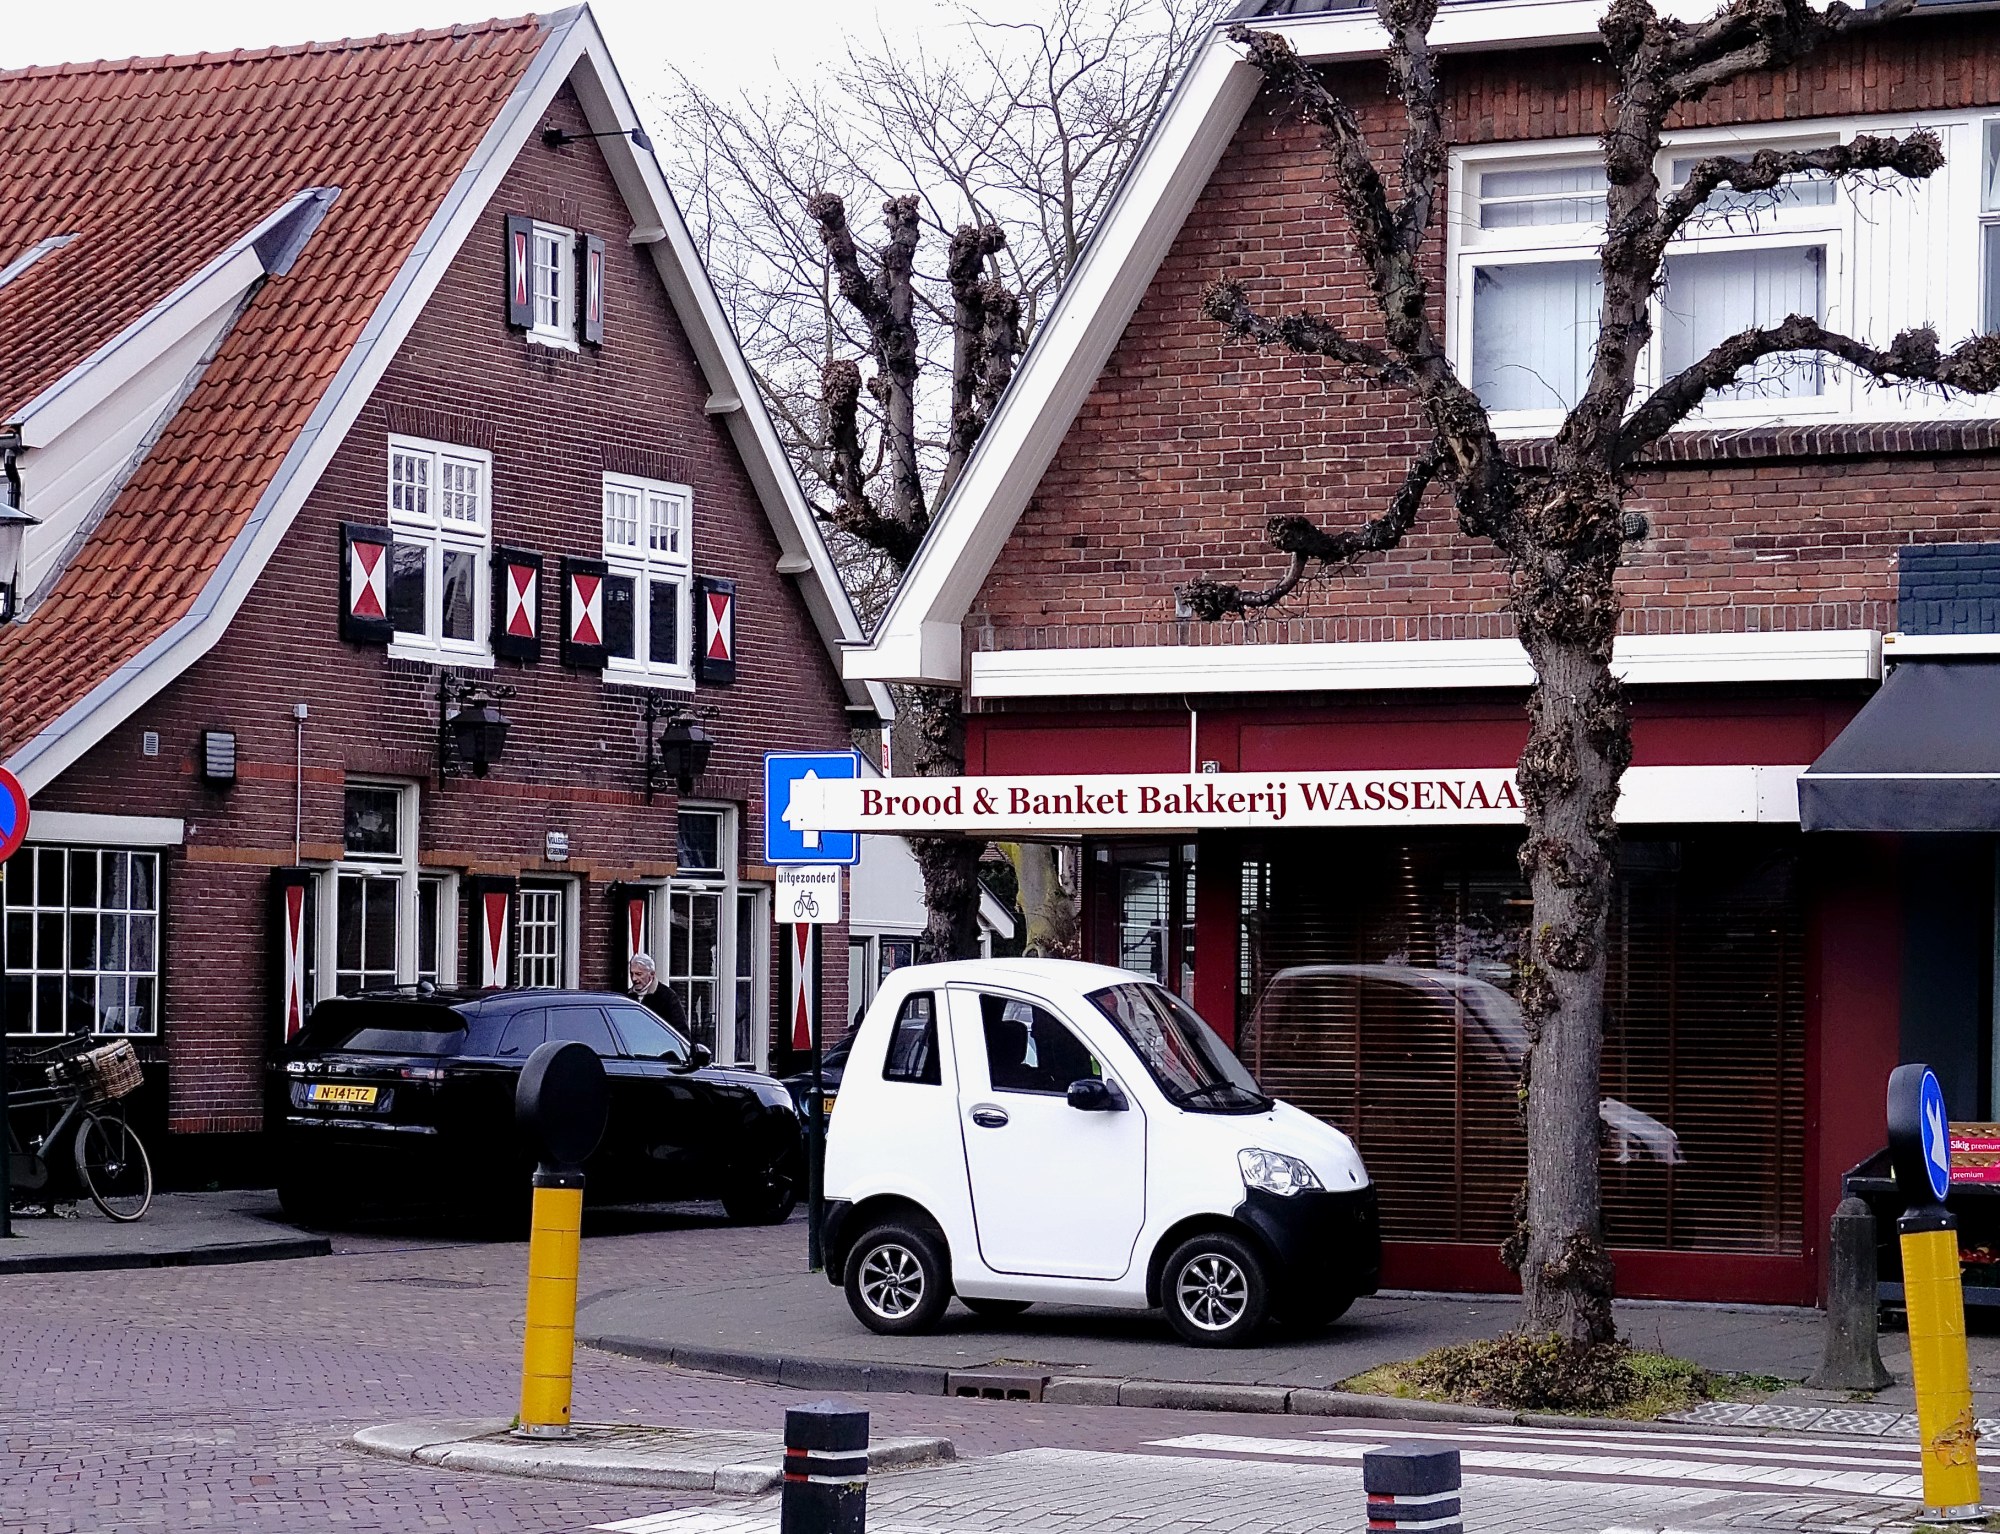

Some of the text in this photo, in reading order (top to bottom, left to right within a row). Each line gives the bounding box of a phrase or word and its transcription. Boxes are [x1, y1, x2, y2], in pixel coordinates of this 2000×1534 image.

[861, 785, 963, 816] Brood
[972, 787, 998, 815] &
[1008, 784, 1128, 815] Banket
[1139, 782, 1288, 820] Bakkerij
[778, 871, 836, 886] uitgezonderd
[321, 1087, 369, 1100] N-141-TZ
[1952, 1171, 1984, 1179] premium
